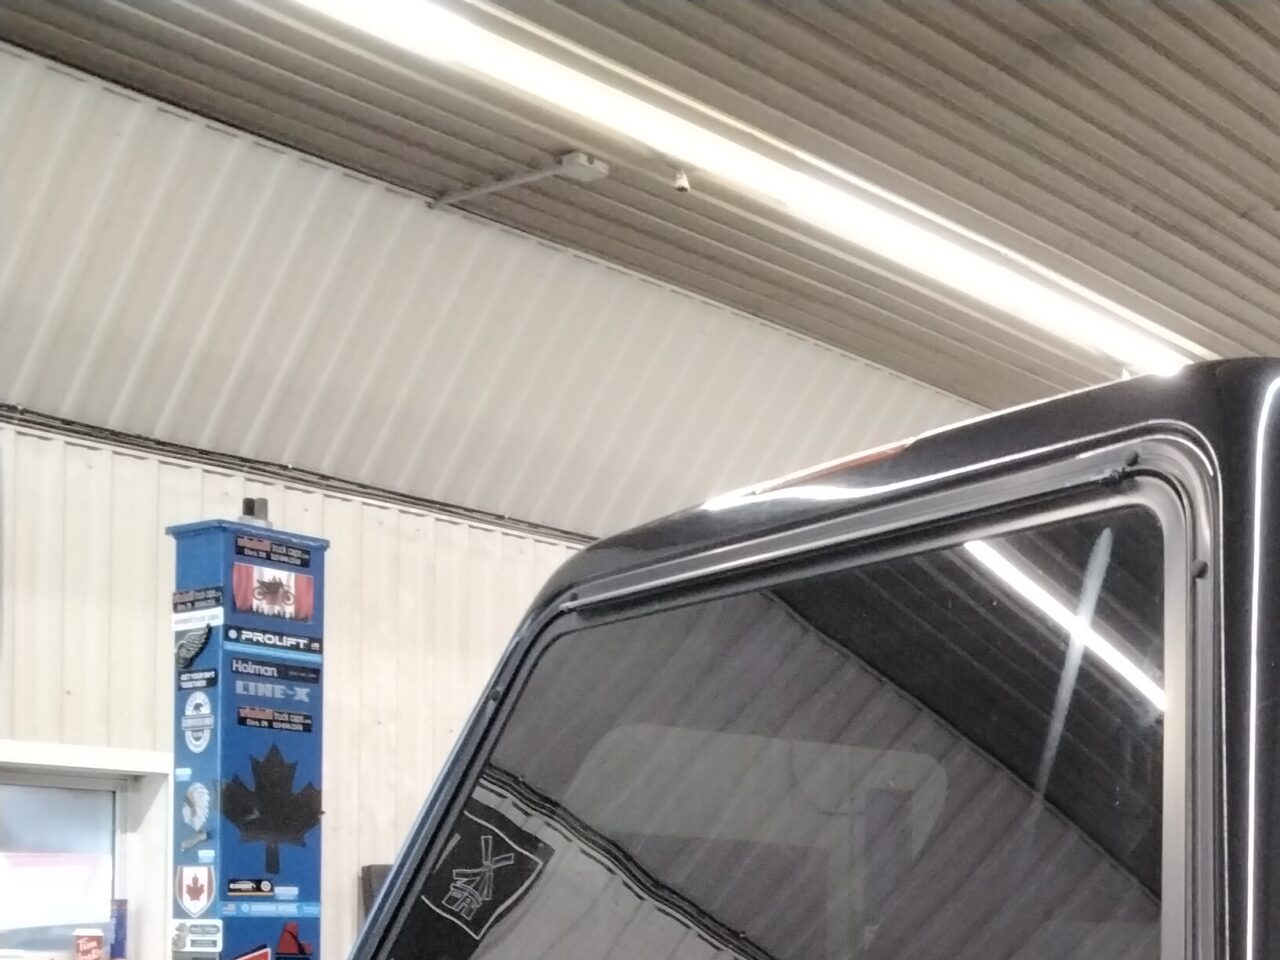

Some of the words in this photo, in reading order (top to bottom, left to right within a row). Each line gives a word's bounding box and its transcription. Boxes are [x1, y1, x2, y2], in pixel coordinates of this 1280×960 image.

[241, 630, 309, 649] PROLIFT
[232, 659, 278, 677] Holman
[235, 680, 311, 702] LINE-X
